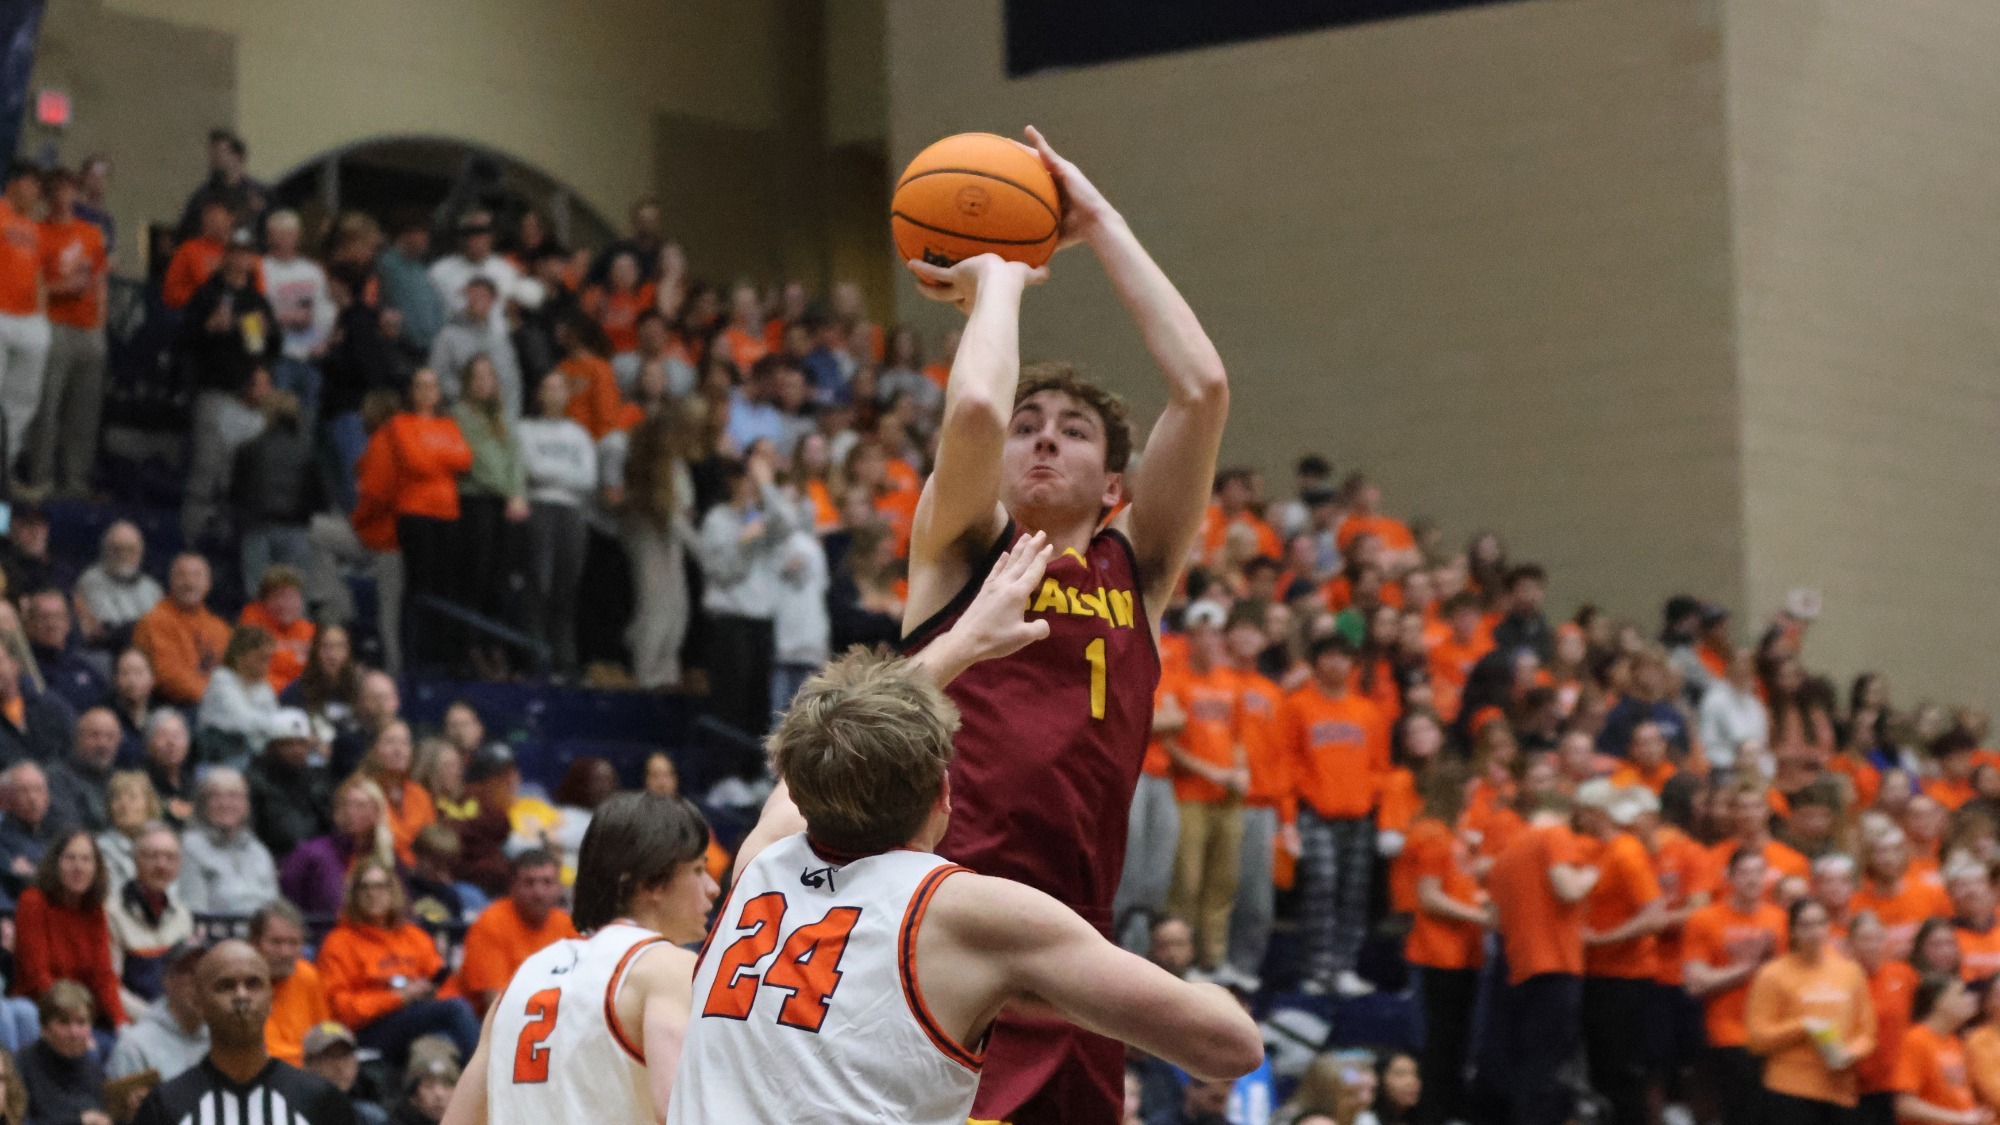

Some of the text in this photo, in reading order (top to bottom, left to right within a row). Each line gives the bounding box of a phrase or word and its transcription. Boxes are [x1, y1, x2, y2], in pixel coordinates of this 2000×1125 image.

[1024, 577, 1135, 629] ALVIN
[1085, 637, 1107, 720] 1
[701, 891, 863, 1033] 24
[512, 986, 562, 1084] 2
